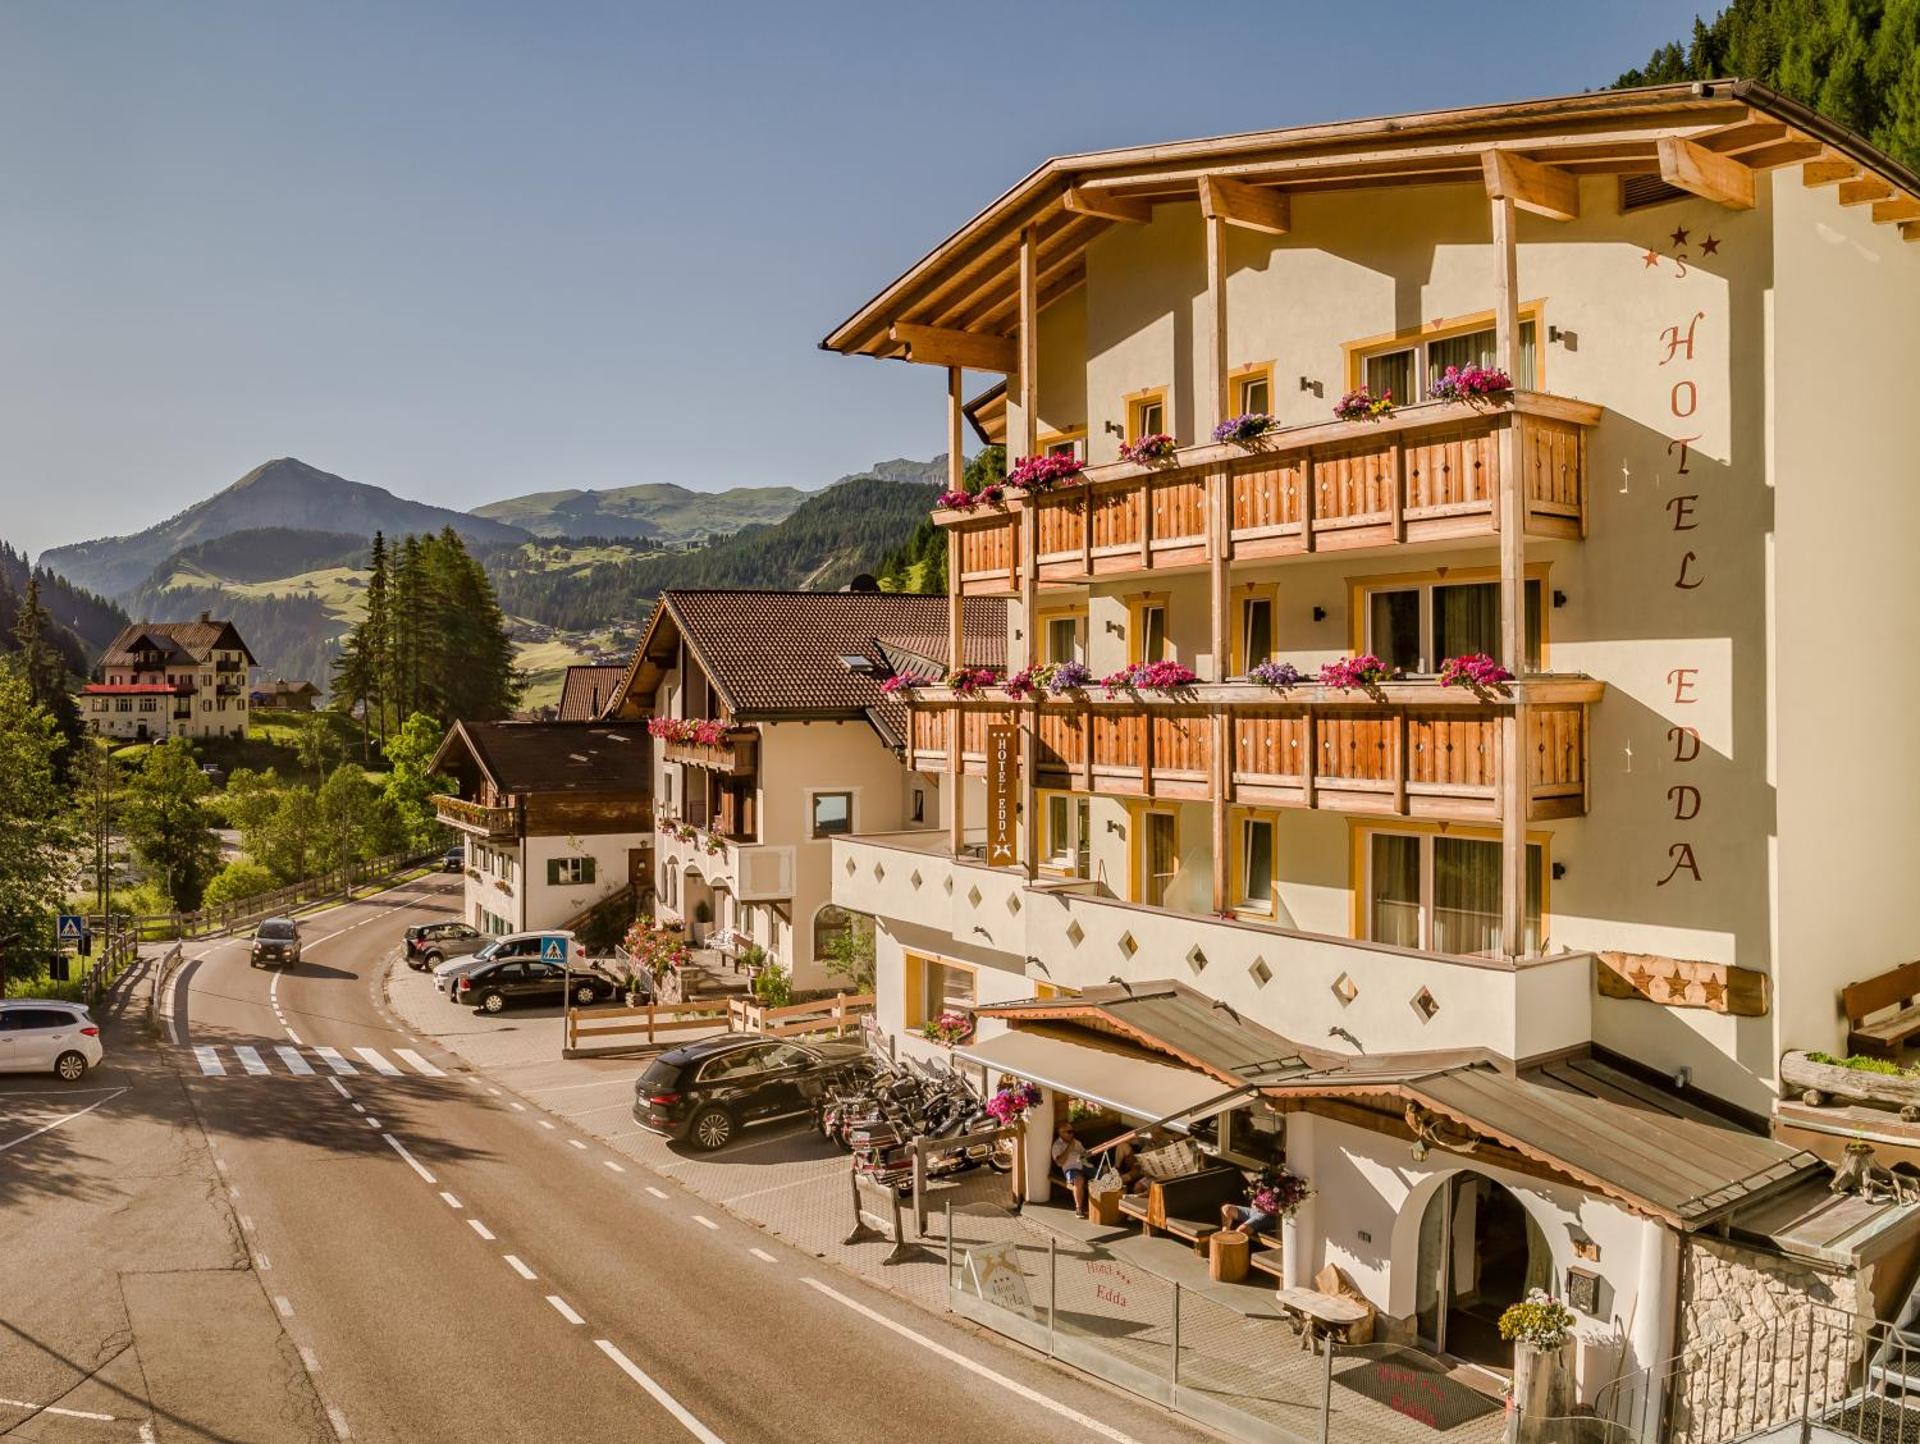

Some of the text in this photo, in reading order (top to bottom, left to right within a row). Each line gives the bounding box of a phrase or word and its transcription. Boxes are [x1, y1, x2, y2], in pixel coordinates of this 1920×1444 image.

[1674, 253, 1689, 279] S
[1656, 311, 1706, 887] HOTEL EDDA
[997, 738, 1007, 842] HOTEL EDDA
[1096, 1284, 1127, 1307] Edda
